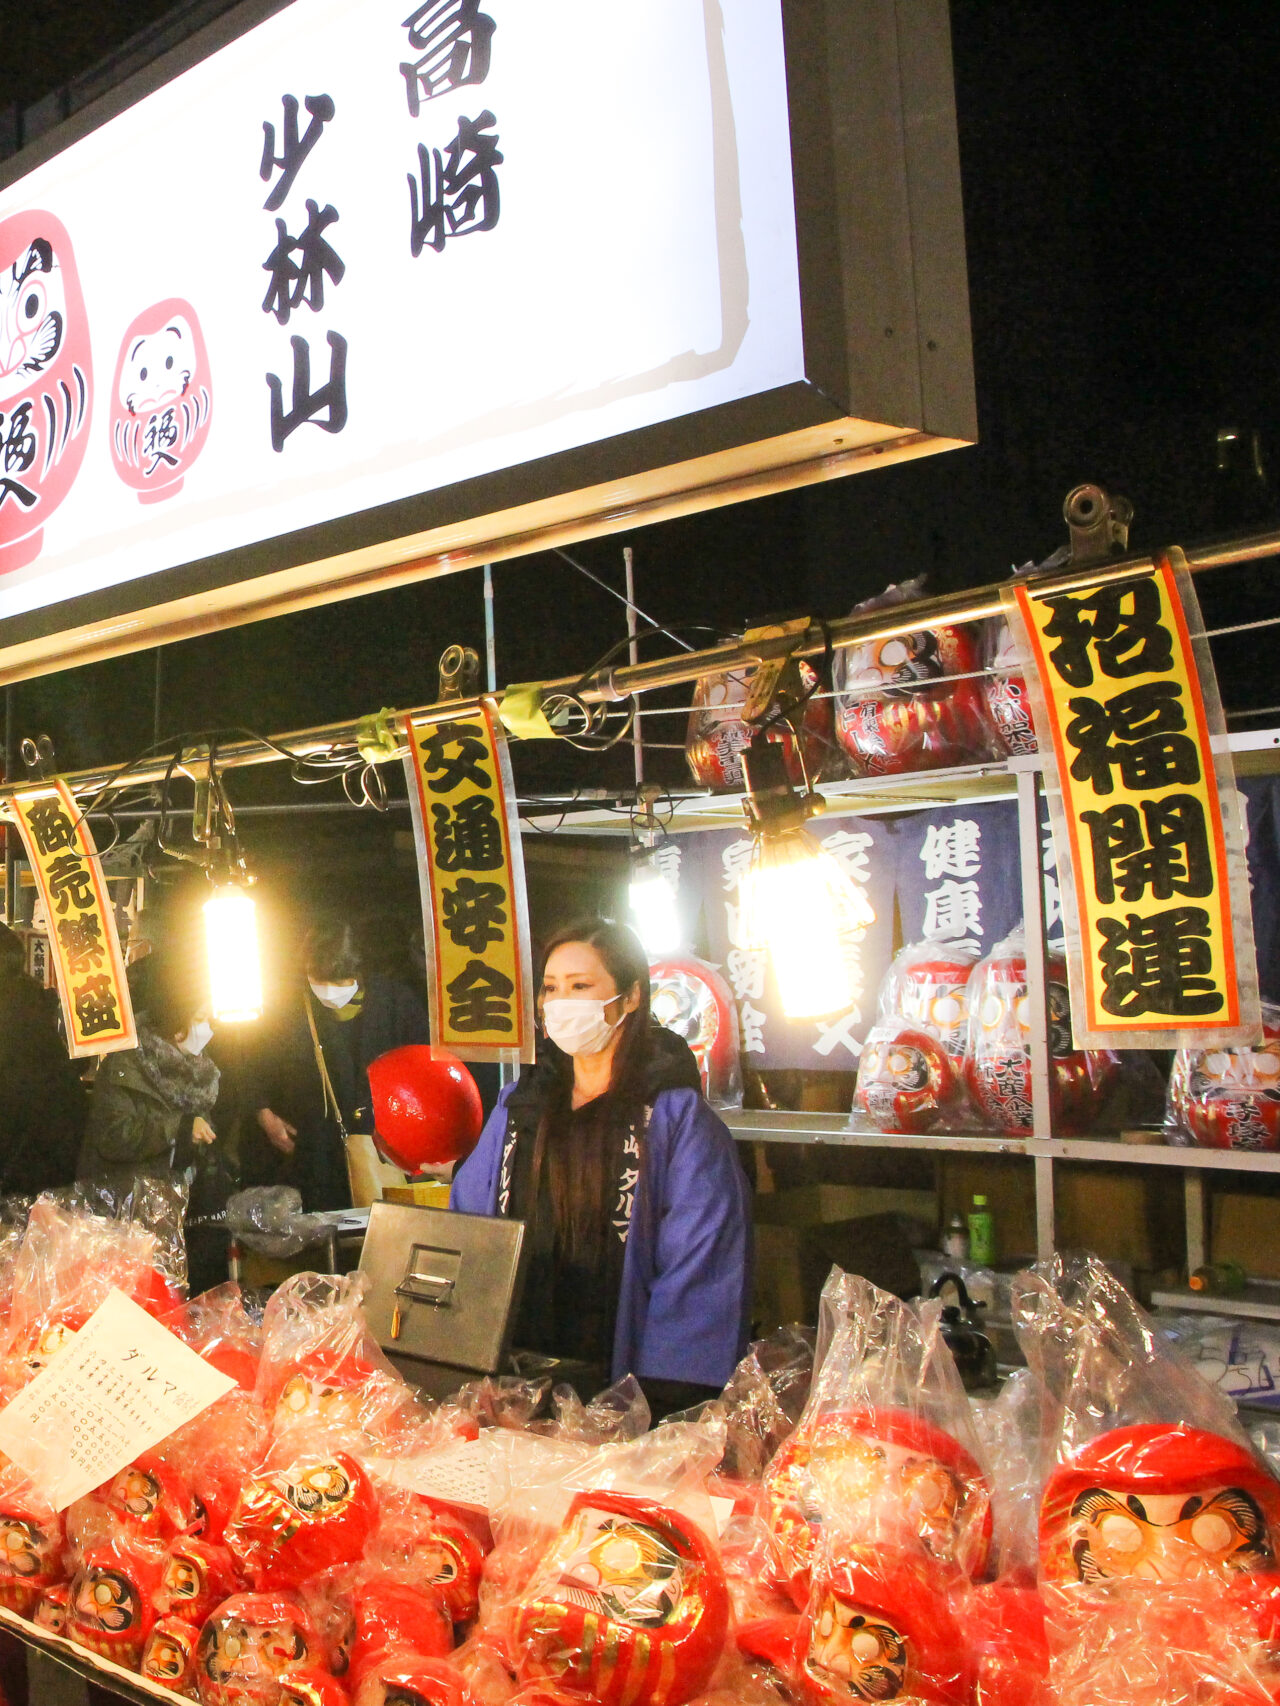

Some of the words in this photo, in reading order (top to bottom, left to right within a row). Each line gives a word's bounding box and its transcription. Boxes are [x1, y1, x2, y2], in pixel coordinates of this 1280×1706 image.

[260, 93, 348, 452] 少林山
[399, 0, 504, 258] 高崎
[25, 796, 121, 1037] 商売繁盛
[419, 722, 516, 1035] 交通安全
[1042, 576, 1224, 1019] 招福開運
